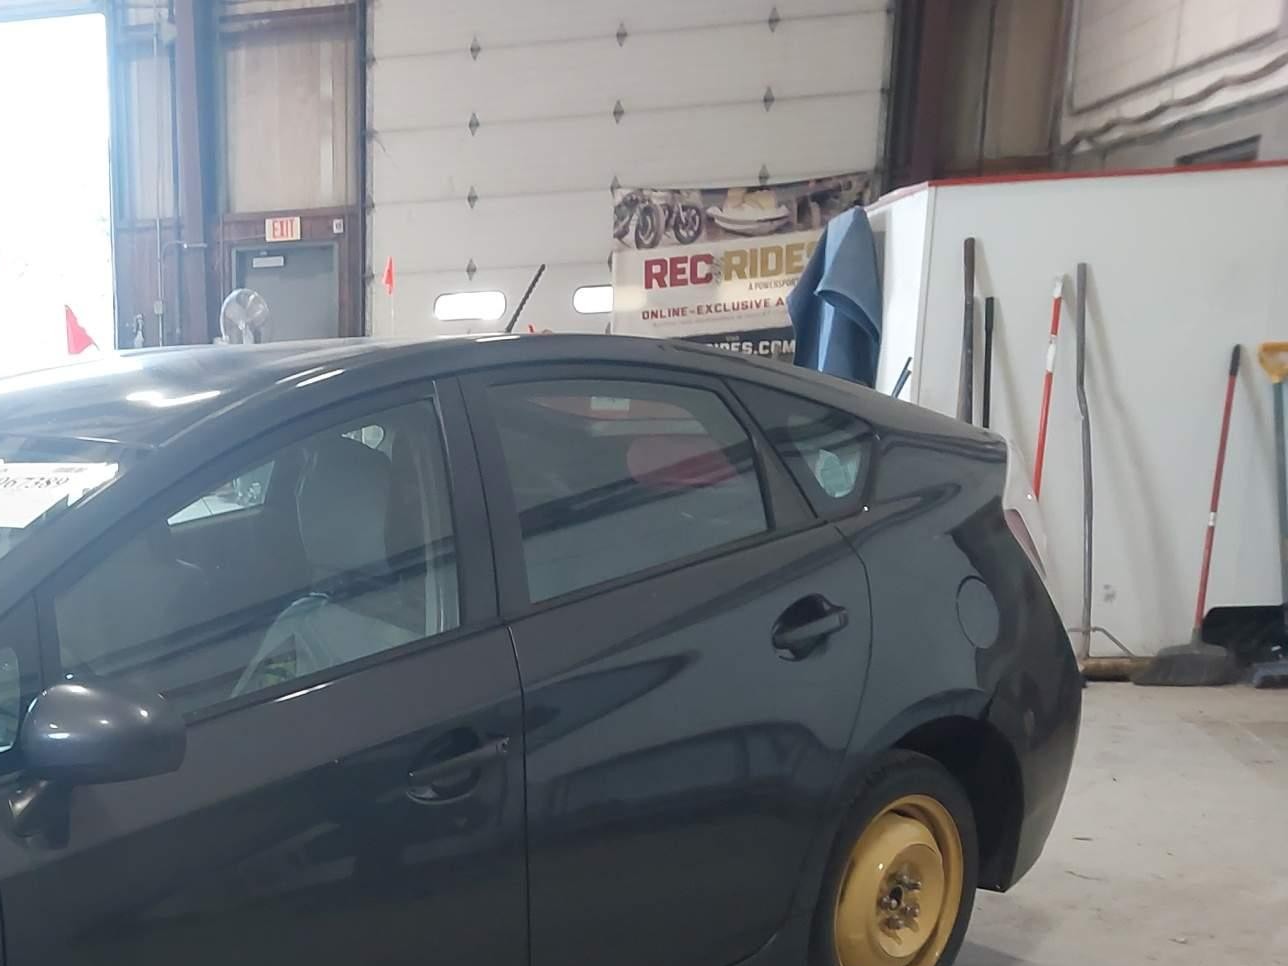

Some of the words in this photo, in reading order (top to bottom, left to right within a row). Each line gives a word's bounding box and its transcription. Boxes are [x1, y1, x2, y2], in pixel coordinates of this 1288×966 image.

[272, 219, 296, 239] EXIT
[644, 253, 713, 290] REC
[723, 241, 818, 281] RIDE
[641, 298, 771, 320] ONLINE-EXCLUSIVE
